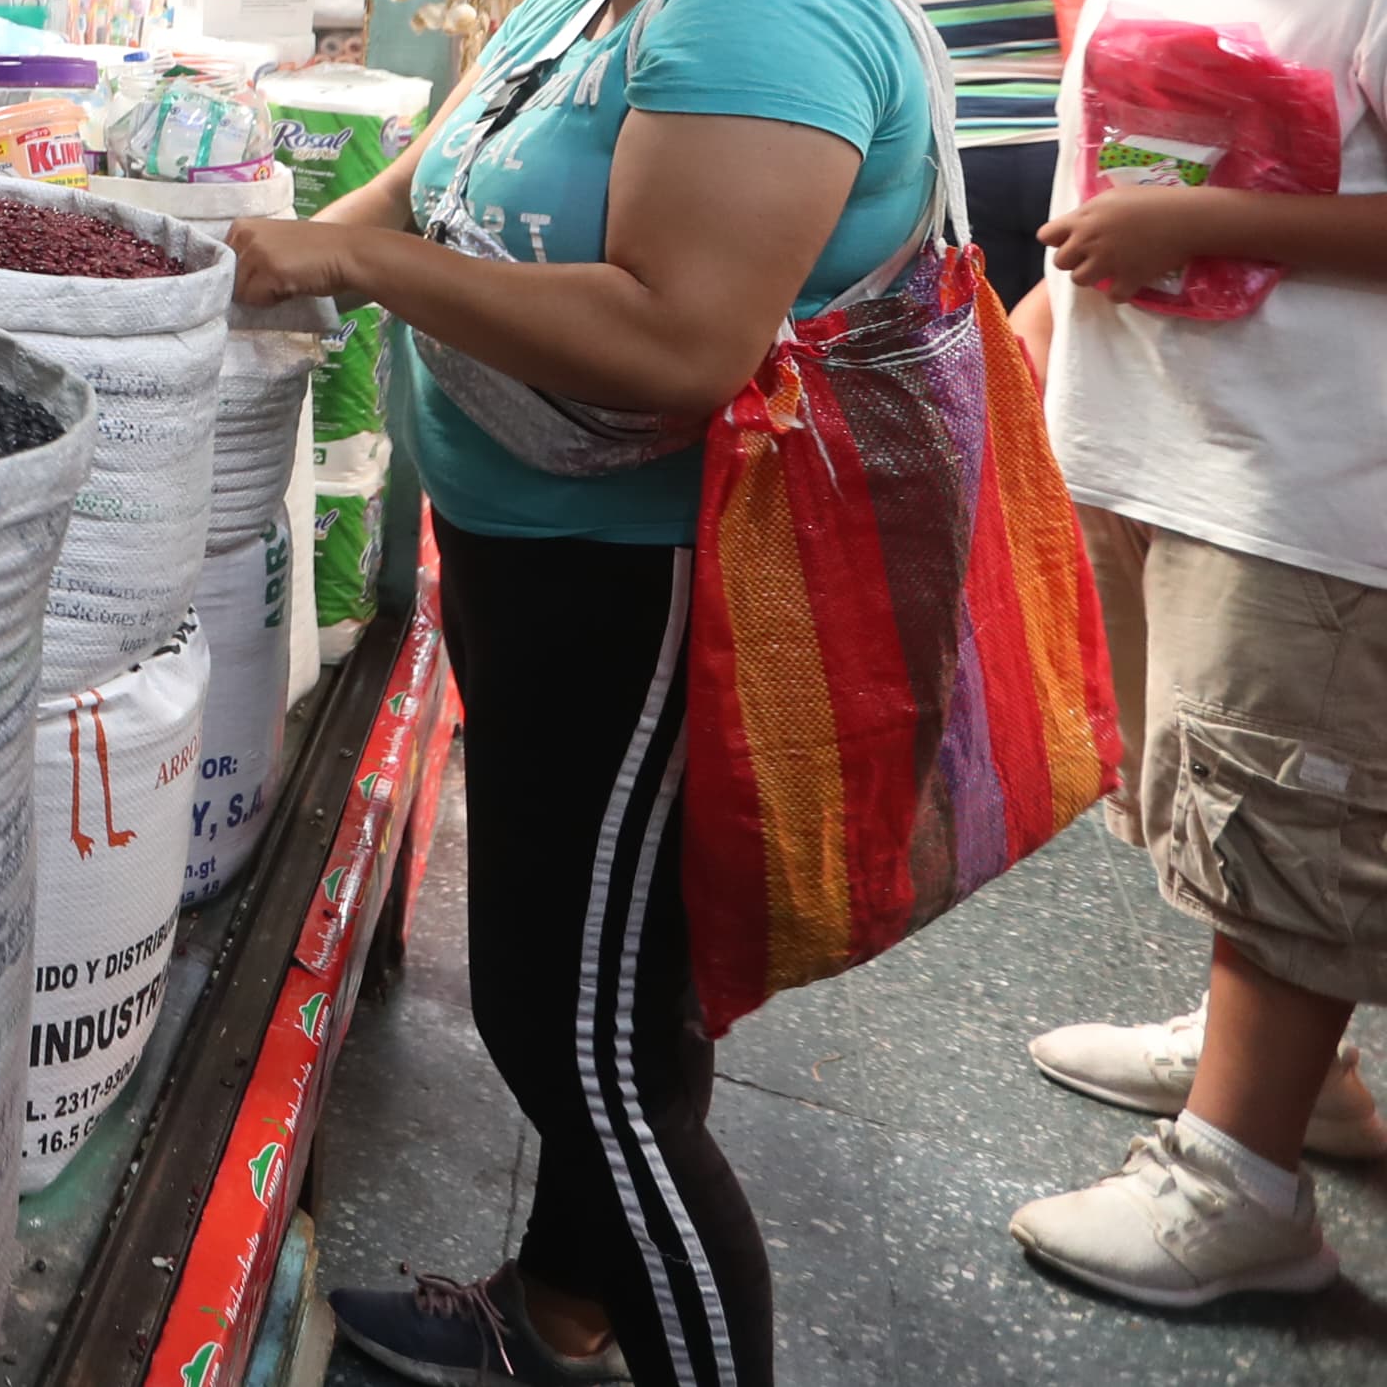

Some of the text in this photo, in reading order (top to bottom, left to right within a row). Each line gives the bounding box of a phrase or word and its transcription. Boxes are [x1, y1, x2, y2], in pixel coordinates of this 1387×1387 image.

[272, 119, 354, 151] Rosal
[87, 963, 104, 986] Y
[28, 971, 168, 1068] INDUSTRI
[37, 1124, 81, 1156] 16.5
